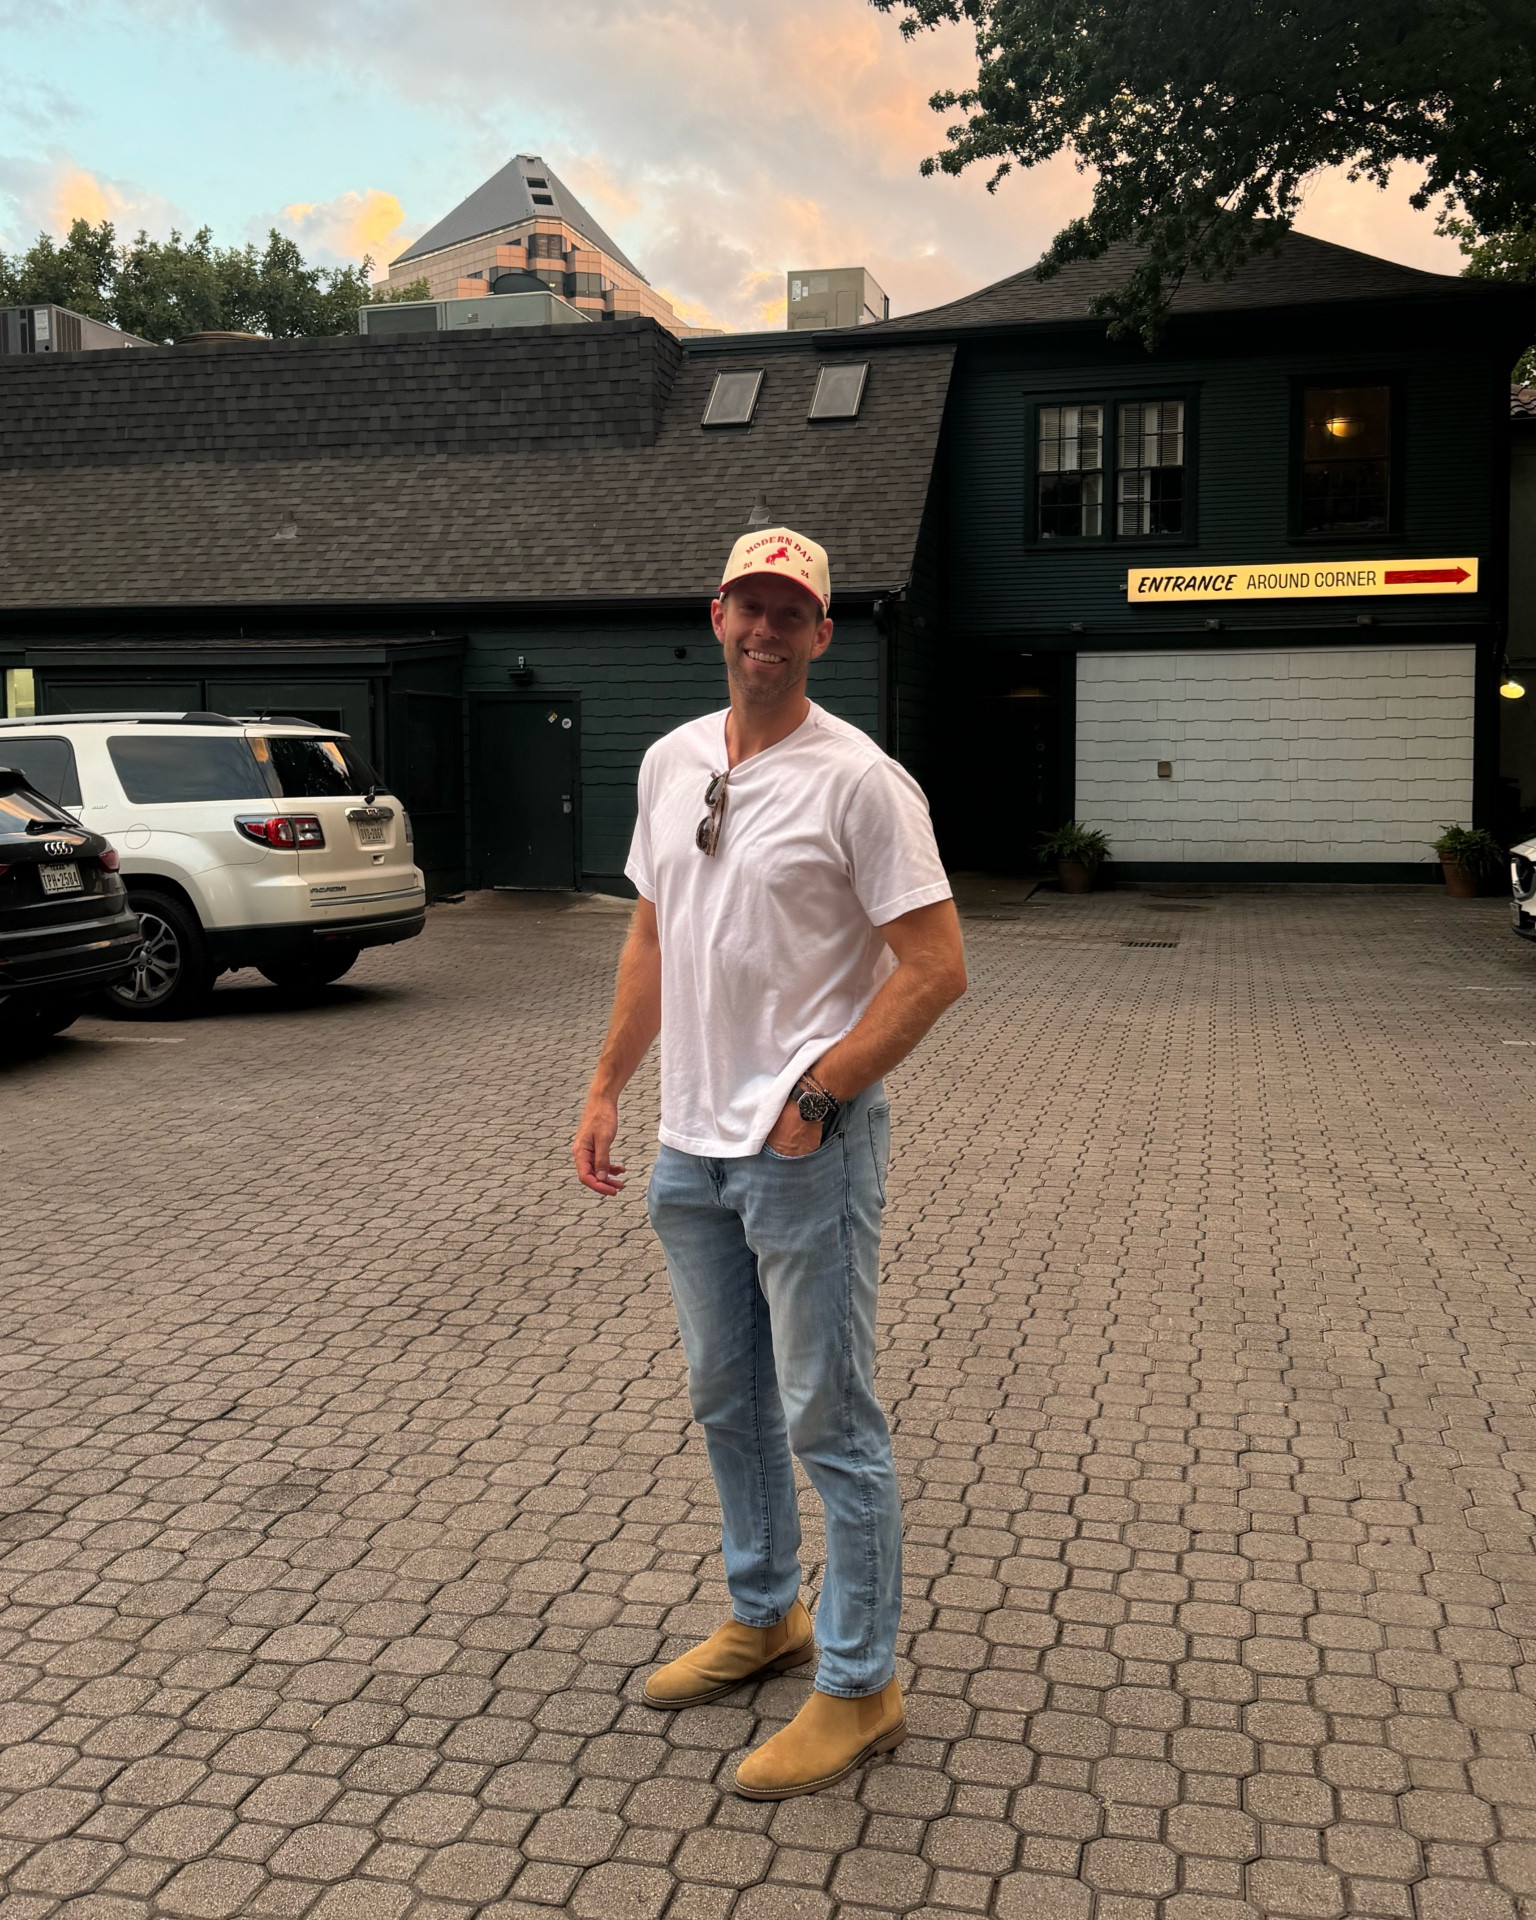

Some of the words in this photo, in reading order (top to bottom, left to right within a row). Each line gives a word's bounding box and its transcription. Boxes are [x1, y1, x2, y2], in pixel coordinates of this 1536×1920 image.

[746, 536, 793, 555] MODERN
[793, 543, 813, 563] DAY
[743, 561, 753, 570] 20
[800, 569, 809, 579] 24
[1137, 574, 1238, 594] ENTRANCE
[1246, 572, 1311, 590] AROUND
[1314, 570, 1377, 588] CORNER
